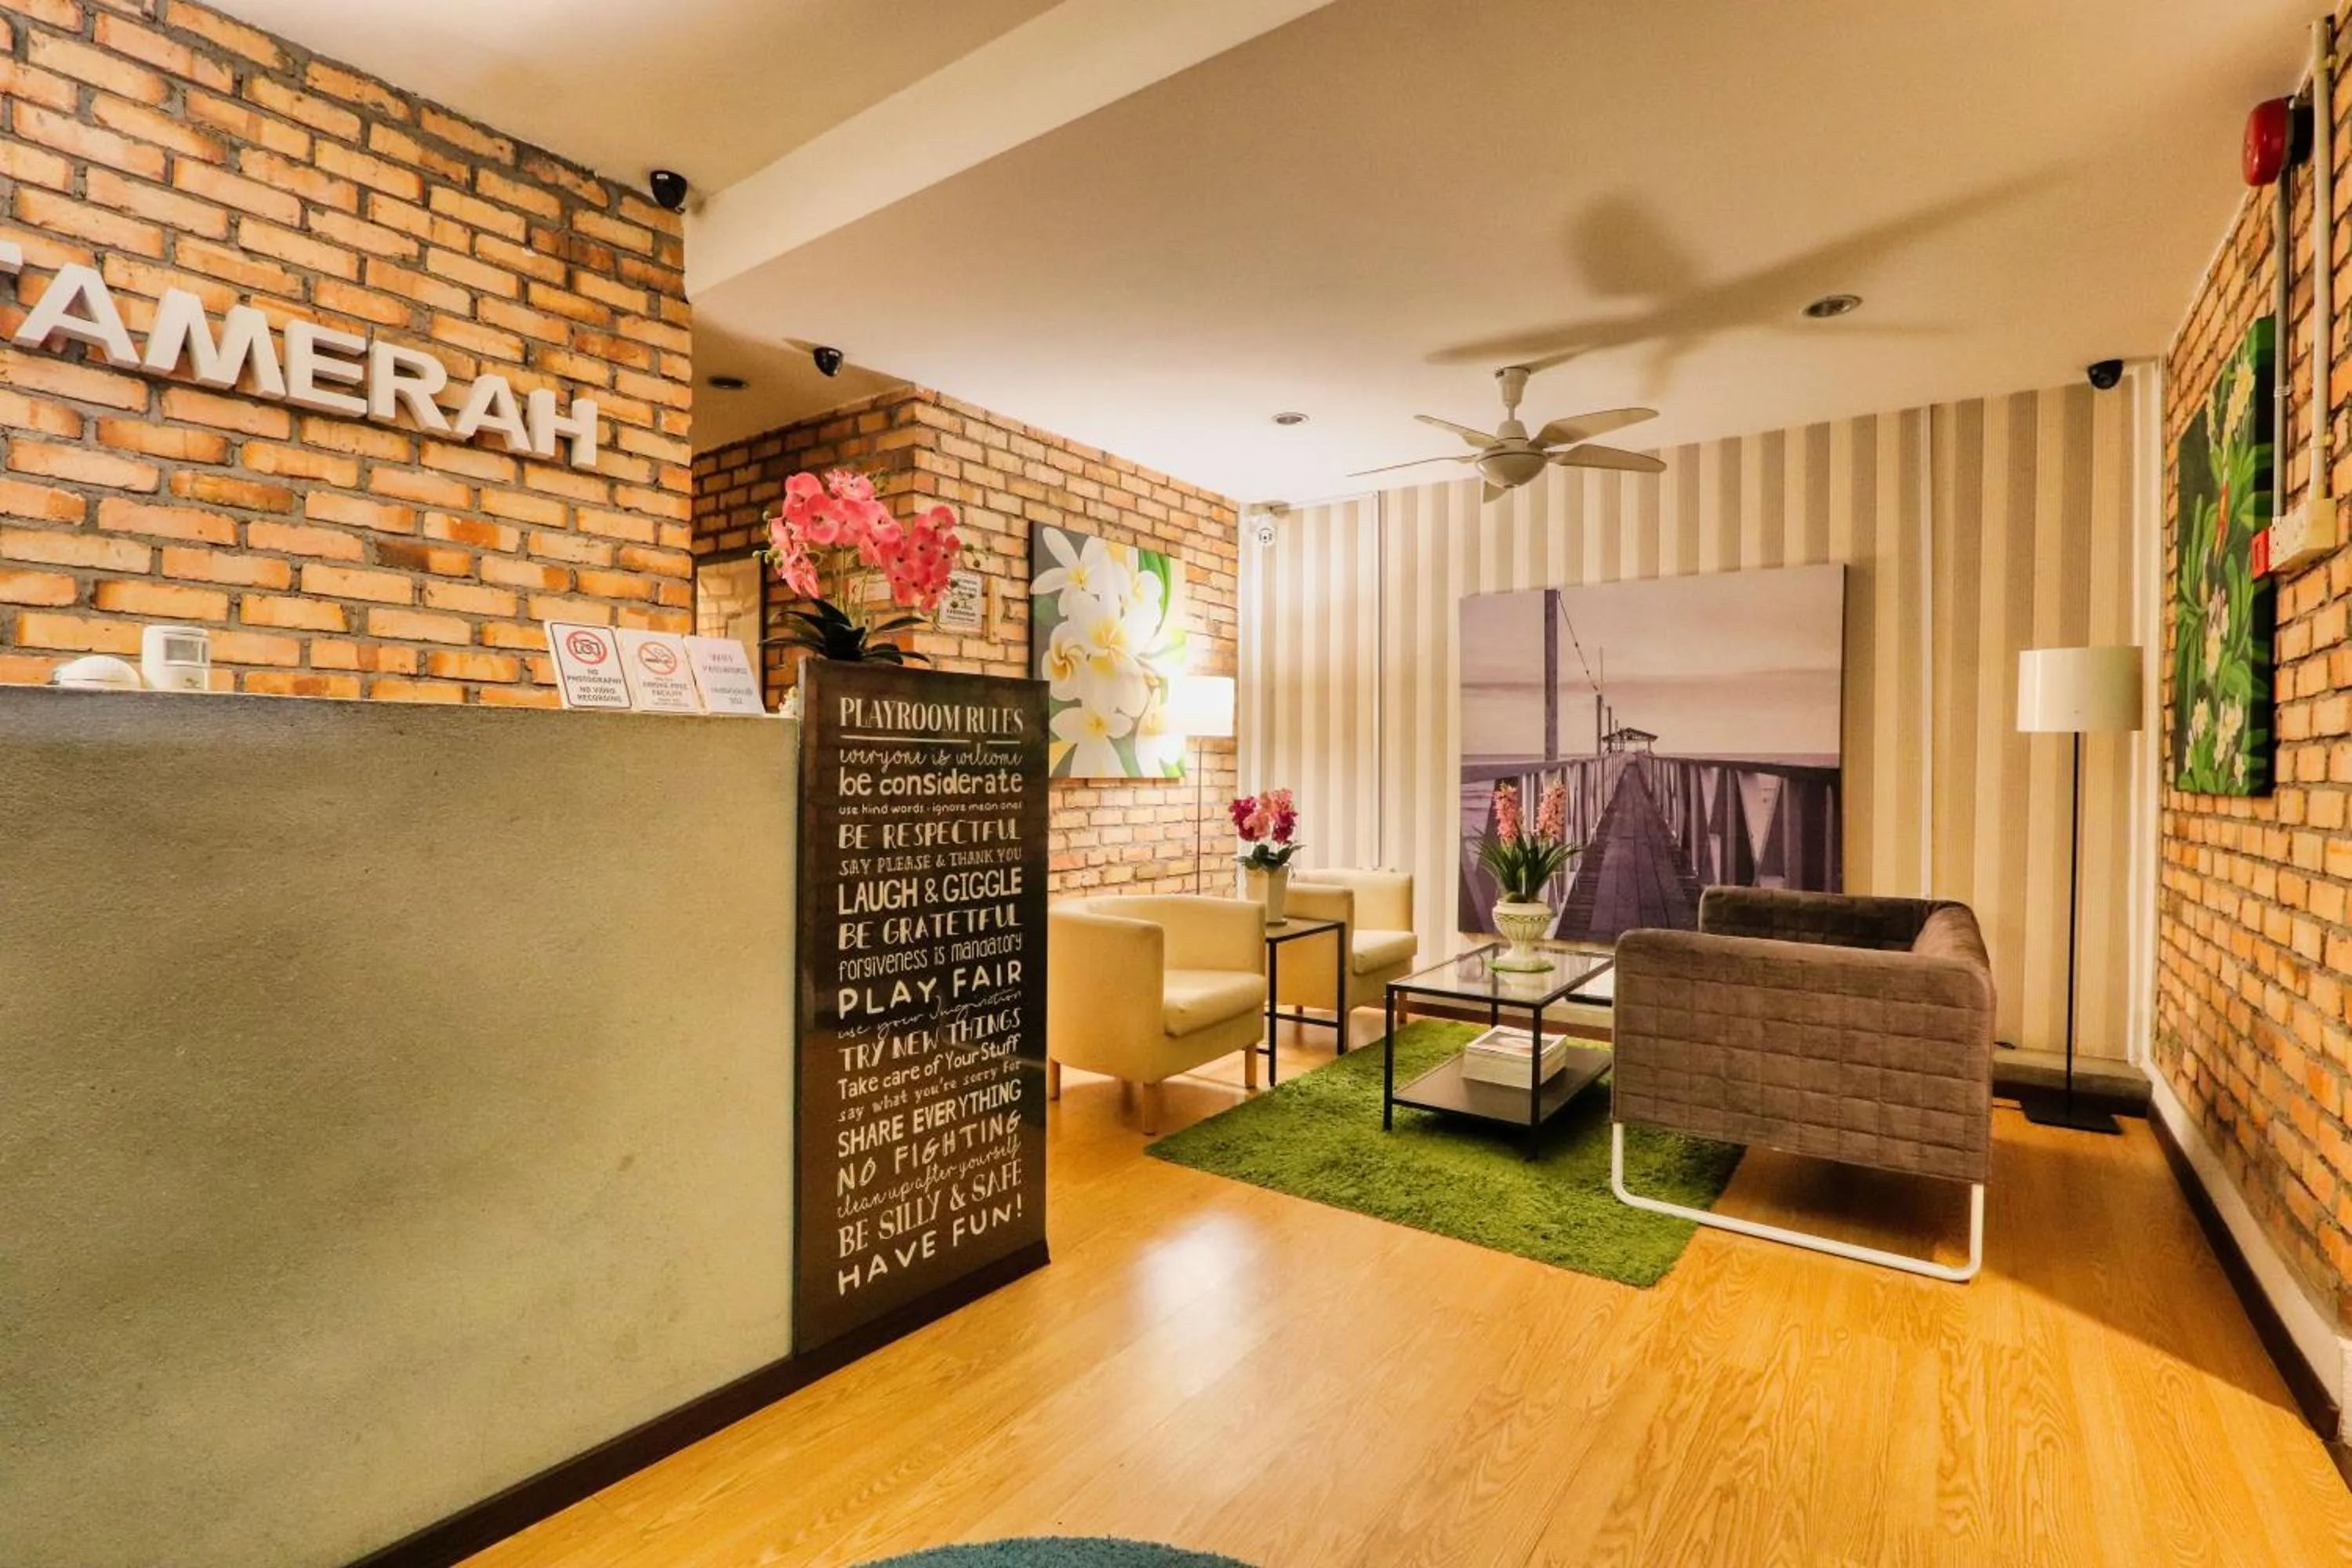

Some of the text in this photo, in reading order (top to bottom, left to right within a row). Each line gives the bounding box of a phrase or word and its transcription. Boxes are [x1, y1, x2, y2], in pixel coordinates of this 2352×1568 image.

[0, 240, 598, 470] AMERAH
[566, 675, 622, 684] PHOTOGRAPHY
[840, 697, 1023, 734] PLAYROOM RULES
[839, 766, 1022, 796] be considerate
[840, 743, 1023, 774] everyone is welcome
[838, 818, 1023, 849] BE RESPECTFUL
[839, 806, 859, 815] use
[862, 804, 888, 815] kind
[891, 803, 924, 814] words
[932, 803, 966, 816] ignore
[969, 803, 998, 811] mean
[838, 847, 1022, 877] SAY PLEASE & THANK YOU
[838, 867, 1022, 915] LAUGH & GIGGLE
[838, 922, 874, 950] BE
[839, 932, 1022, 982] forgiveness is mandatory
[838, 960, 1022, 1019] PLAY FAIR
[837, 1033, 1022, 1100] Take care of Your Stuff
[838, 1007, 1022, 1073] TRY NEW THINGS
[838, 1105, 865, 1123] say
[871, 1090, 908, 1113] what
[914, 1076, 957, 1104] you're
[963, 1066, 997, 1087] sorry
[838, 1079, 1022, 1158] SHARE EVERYTHING
[837, 1110, 1022, 1198] NO FIGHTING
[837, 1194, 887, 1218] clean
[913, 1162, 956, 1193] after
[958, 1133, 1022, 1179] yourself
[838, 1159, 1022, 1258] BE SILLY & SAFE
[838, 1193, 1022, 1295] HAVE FUN!
